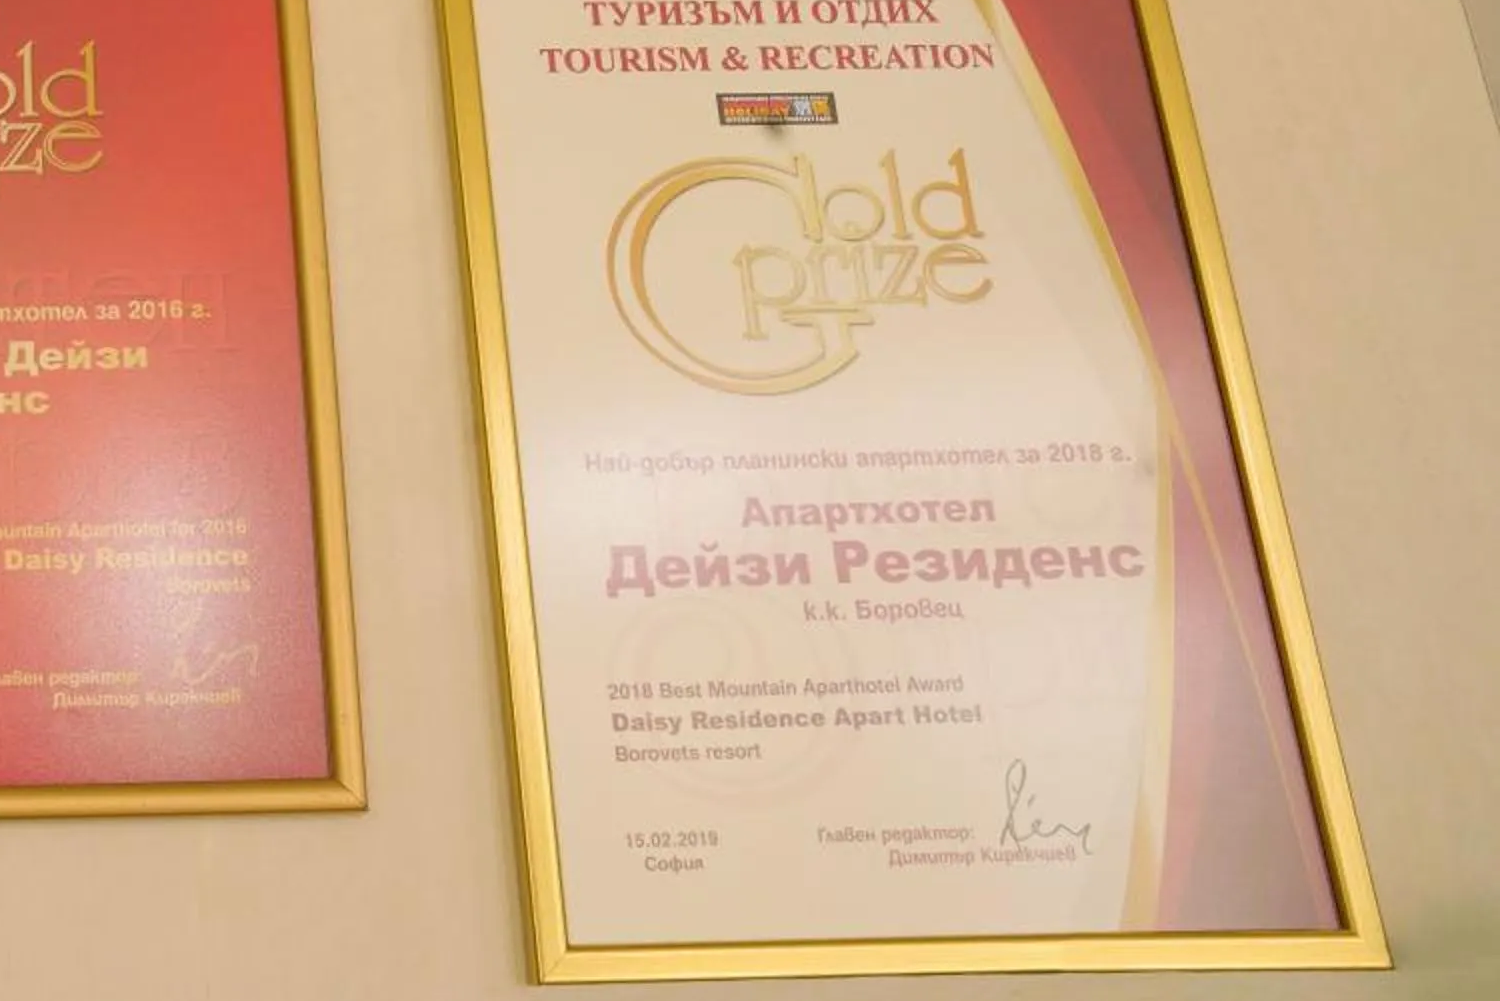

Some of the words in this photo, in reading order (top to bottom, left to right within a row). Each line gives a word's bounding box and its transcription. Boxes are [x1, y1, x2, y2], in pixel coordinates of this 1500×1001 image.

[583, 0, 764, 27] ТУРИЗЪМ
[775, 0, 801, 24] И
[540, 46, 711, 74] TOURISM
[722, 46, 749, 71] &
[759, 43, 995, 71] RECREATION
[95, 303, 120, 320] за
[128, 299, 183, 319] 2016
[4, 339, 148, 376] Дейзи
[584, 452, 714, 477] Най-добър
[723, 449, 848, 470] планински
[856, 447, 1010, 472] апартхотел
[1016, 447, 1040, 464] за
[1047, 443, 1103, 463] 2018
[740, 496, 997, 532] Апартхотел
[4, 546, 84, 575] Daisy
[606, 541, 812, 599] Дейзи
[831, 539, 1146, 589] Резиденс
[803, 599, 847, 621] к.к.
[855, 598, 964, 624] Боровец
[607, 683, 654, 701] 2018
[659, 682, 702, 700] Best
[708, 679, 797, 698] Mountain
[803, 676, 901, 698] Aparthotel
[906, 674, 964, 693] Award
[611, 712, 682, 736] Daisy
[691, 710, 826, 731] Residence
[834, 707, 905, 730] Apart
[913, 704, 982, 725] Hotel
[615, 745, 700, 763] Borovets
[706, 743, 761, 761] resort
[817, 826, 876, 843] Главен
[644, 854, 704, 876] София
[888, 848, 975, 869] Димитър
